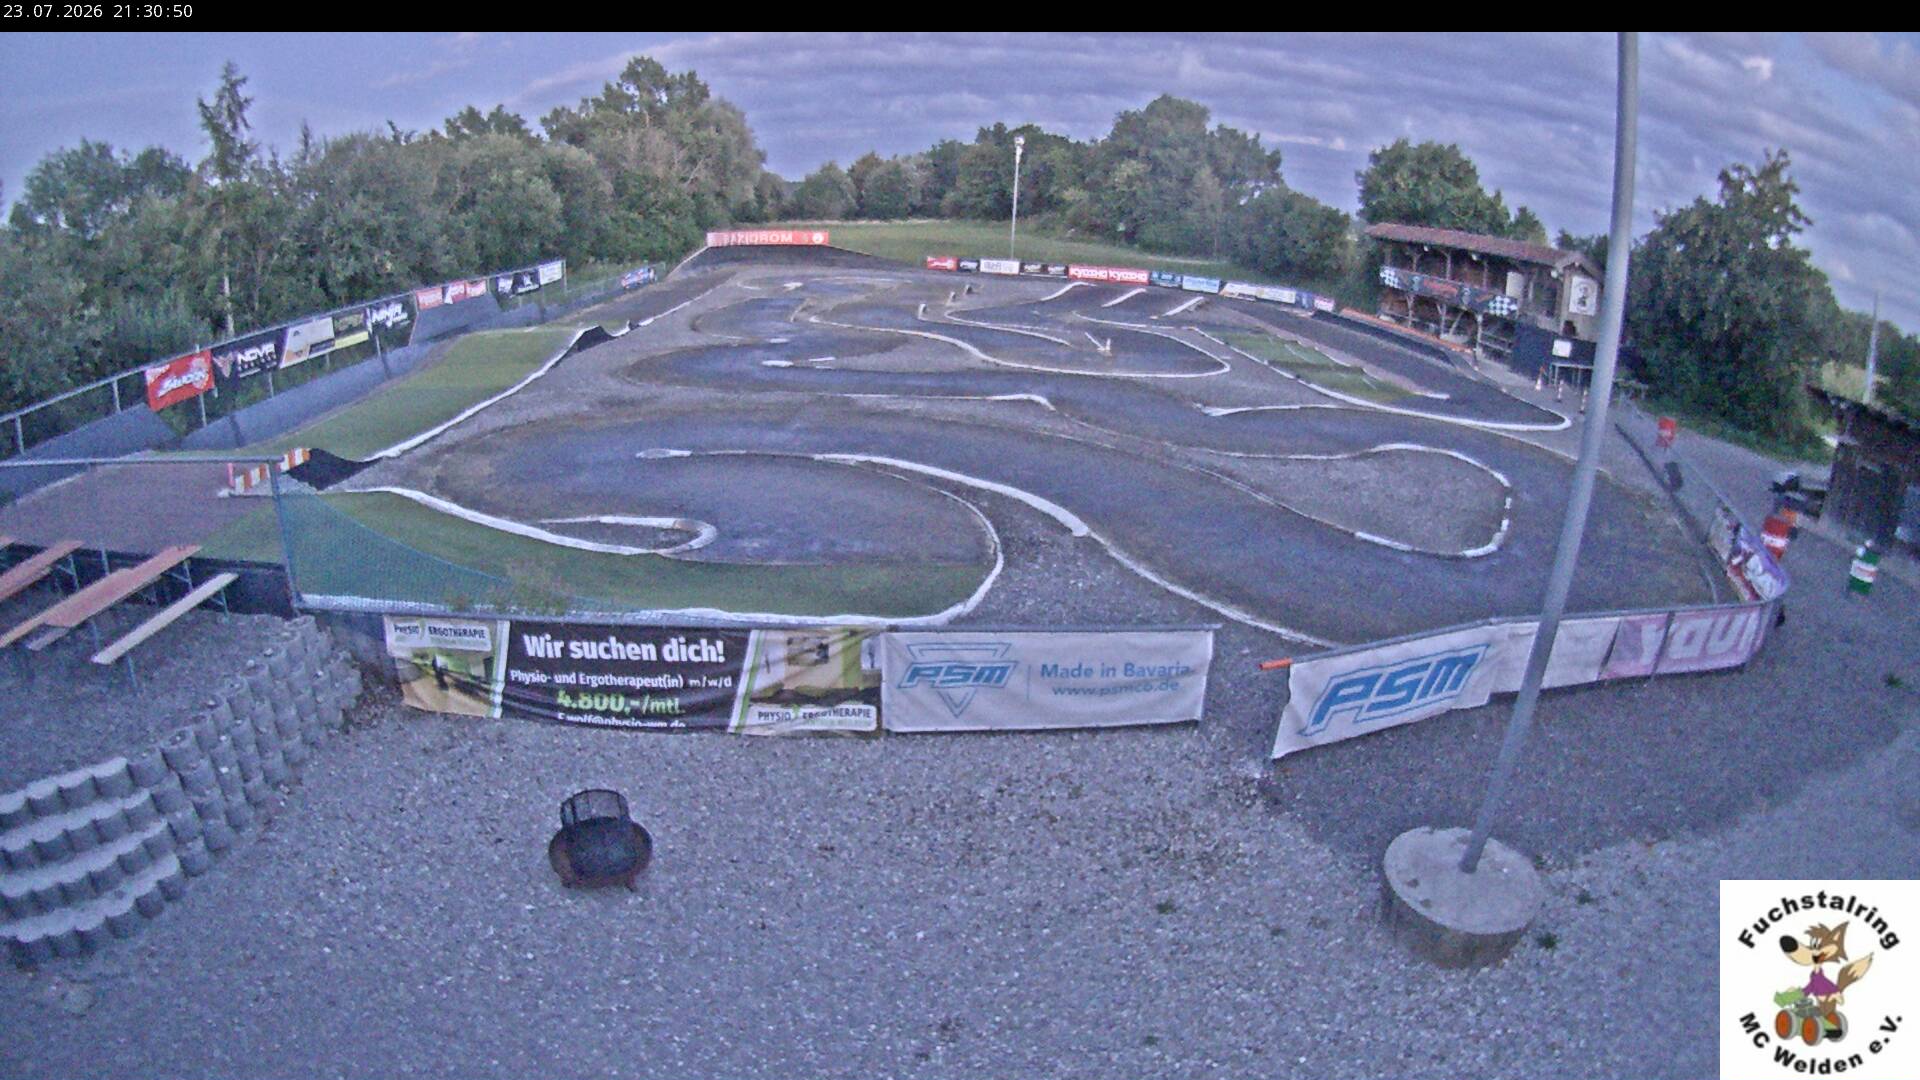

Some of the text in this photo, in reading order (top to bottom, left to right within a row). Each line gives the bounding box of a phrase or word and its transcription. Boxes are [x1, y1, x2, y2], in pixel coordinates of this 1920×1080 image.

[428, 625, 487, 640] ERGOTHERAPIE
[522, 634, 726, 663] Wir suchen dich!
[1040, 660, 1191, 678] Made in Bavaria
[509, 668, 733, 690] Physio- und Ergotherapeut(in) m/w/d
[1052, 679, 1180, 698] www.psmco.de
[1309, 651, 1481, 728] PSM
[757, 710, 792, 721] PHYSIO
